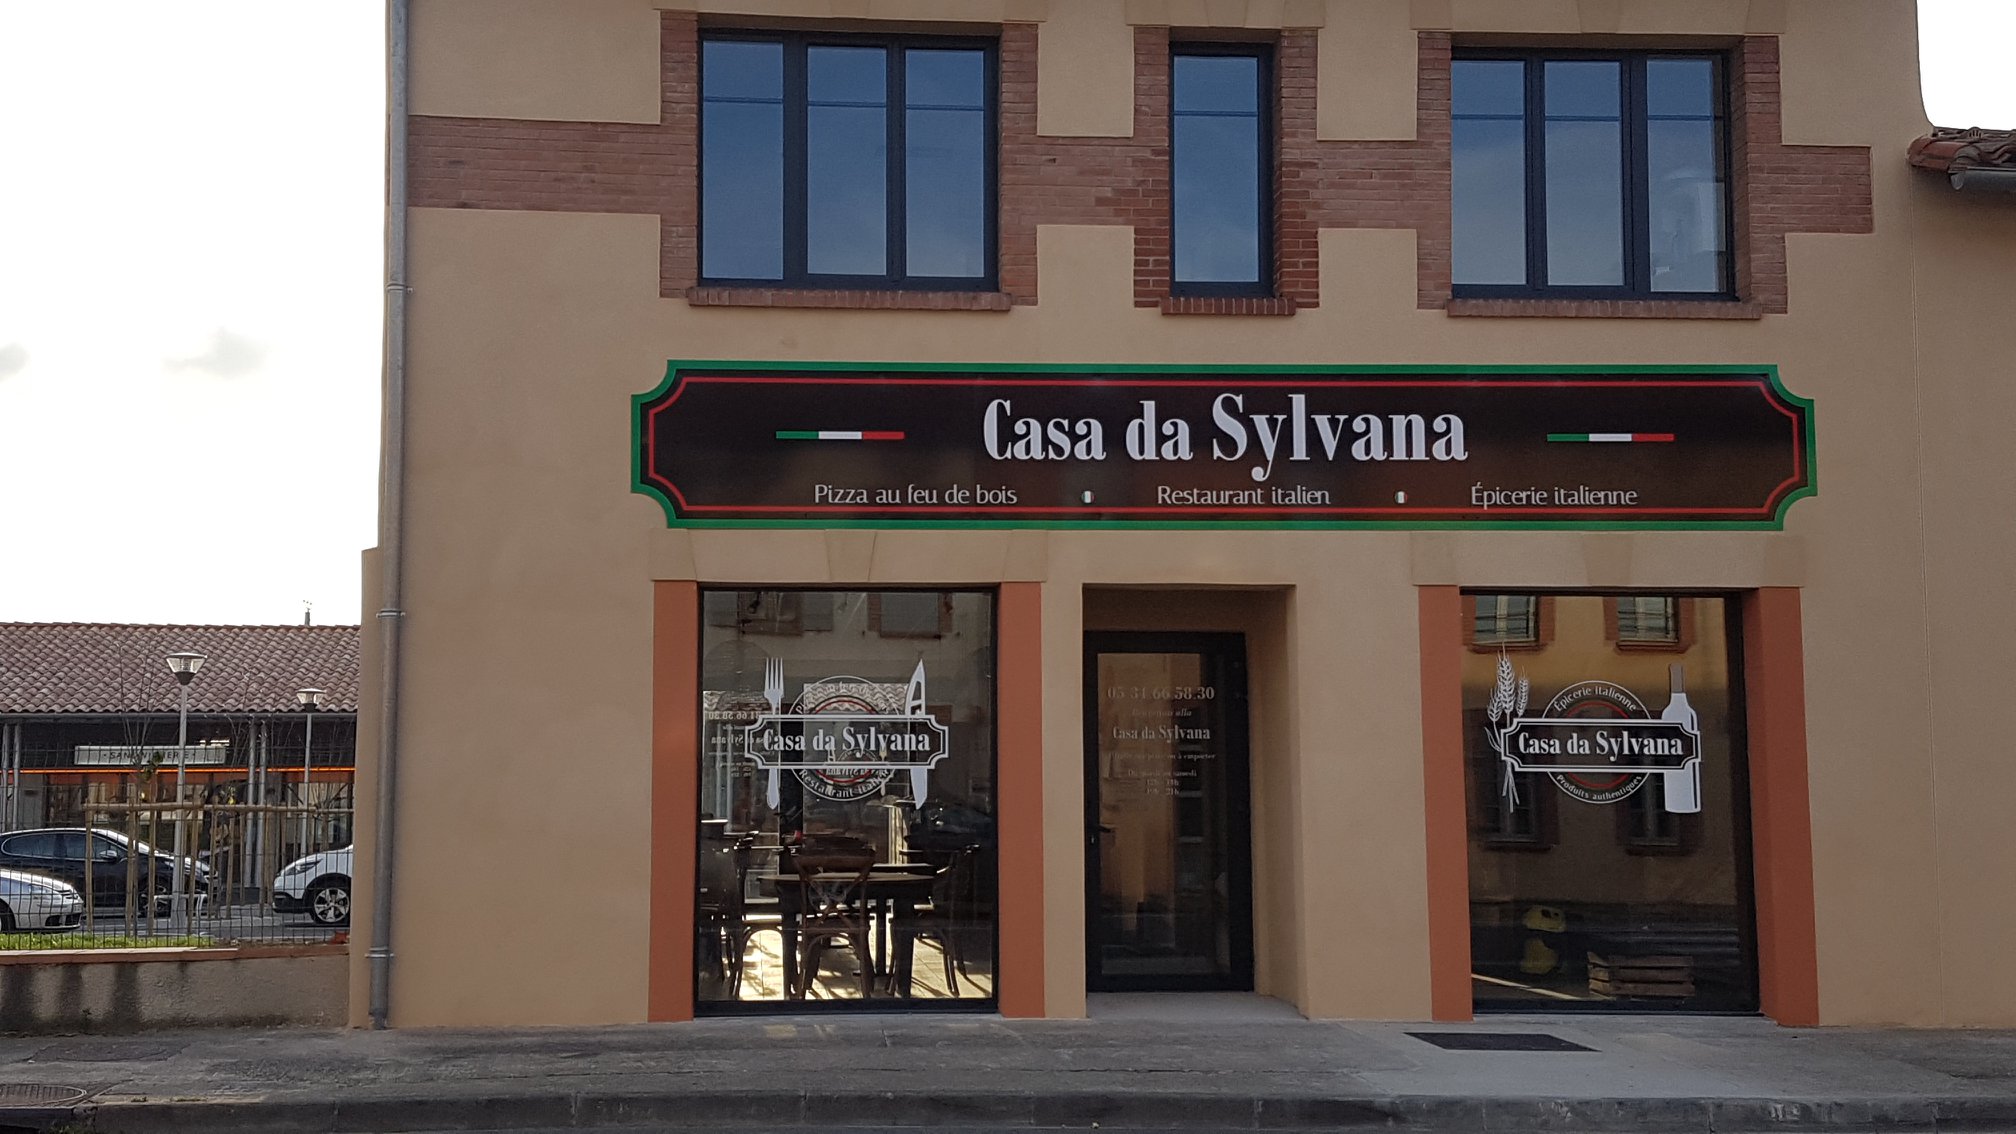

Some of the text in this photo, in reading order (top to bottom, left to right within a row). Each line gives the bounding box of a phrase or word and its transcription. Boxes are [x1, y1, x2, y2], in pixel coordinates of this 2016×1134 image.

[983, 392, 1468, 482] Casa da Sylvana
[813, 483, 1018, 504] Pizza au feu de bois
[1156, 484, 1330, 505] Restaurant italien
[1471, 481, 1638, 509] Épicerie italienne
[1554, 685, 1638, 712] Épicerie italienne
[763, 726, 931, 758] Casa da Sylvana
[1113, 724, 1211, 743] Casa da Sylvana
[1518, 730, 1684, 762] Casa da Sylvana
[1556, 774, 1643, 801] Produits authentiques
